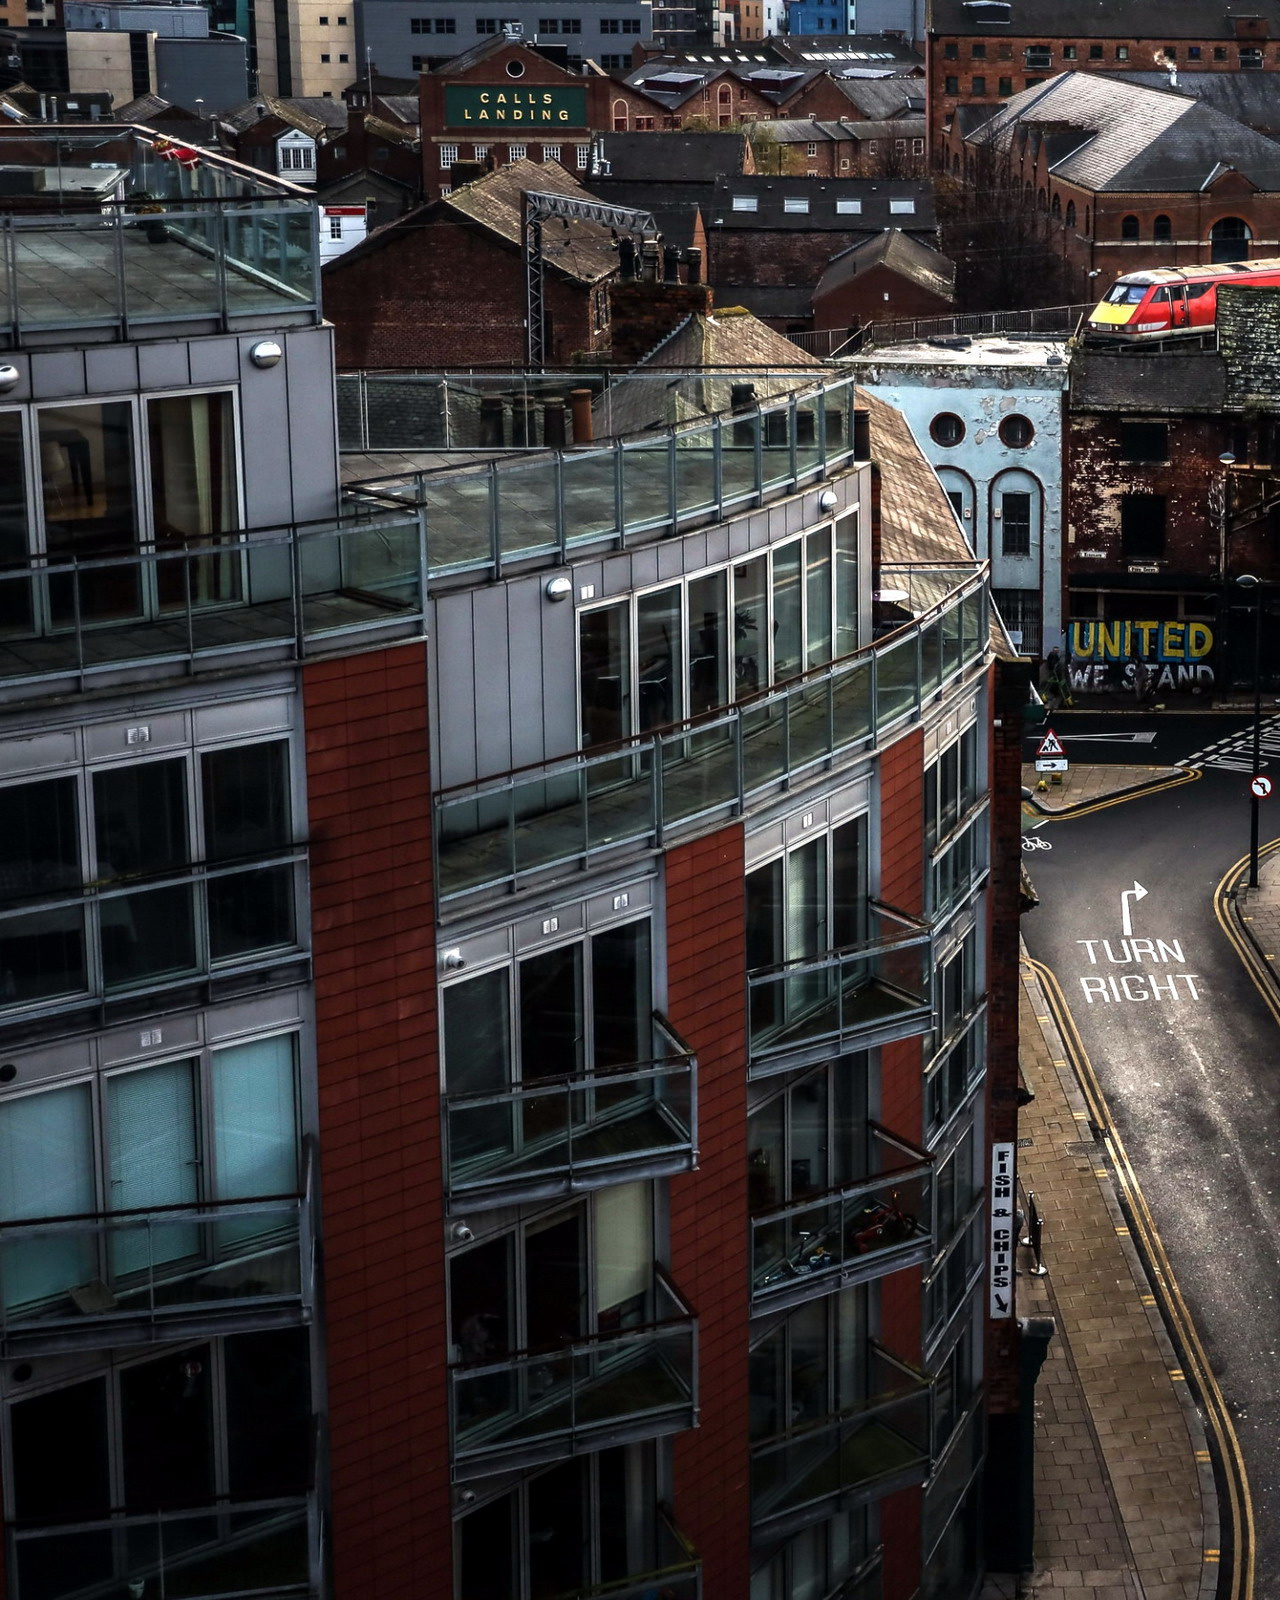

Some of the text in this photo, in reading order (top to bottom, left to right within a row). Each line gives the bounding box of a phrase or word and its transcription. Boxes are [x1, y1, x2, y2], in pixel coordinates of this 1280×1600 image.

[479, 92, 553, 104] CALLS
[464, 108, 569, 121] LANDING
[1067, 620, 1214, 661] UNITED
[1067, 664, 1215, 690] WE STAND
[1205, 756, 1269, 773] NO
[1075, 938, 1186, 964] TURN
[1079, 974, 1199, 1003] RIGHT
[992, 1151, 1012, 1288] FISH & CHIPS
